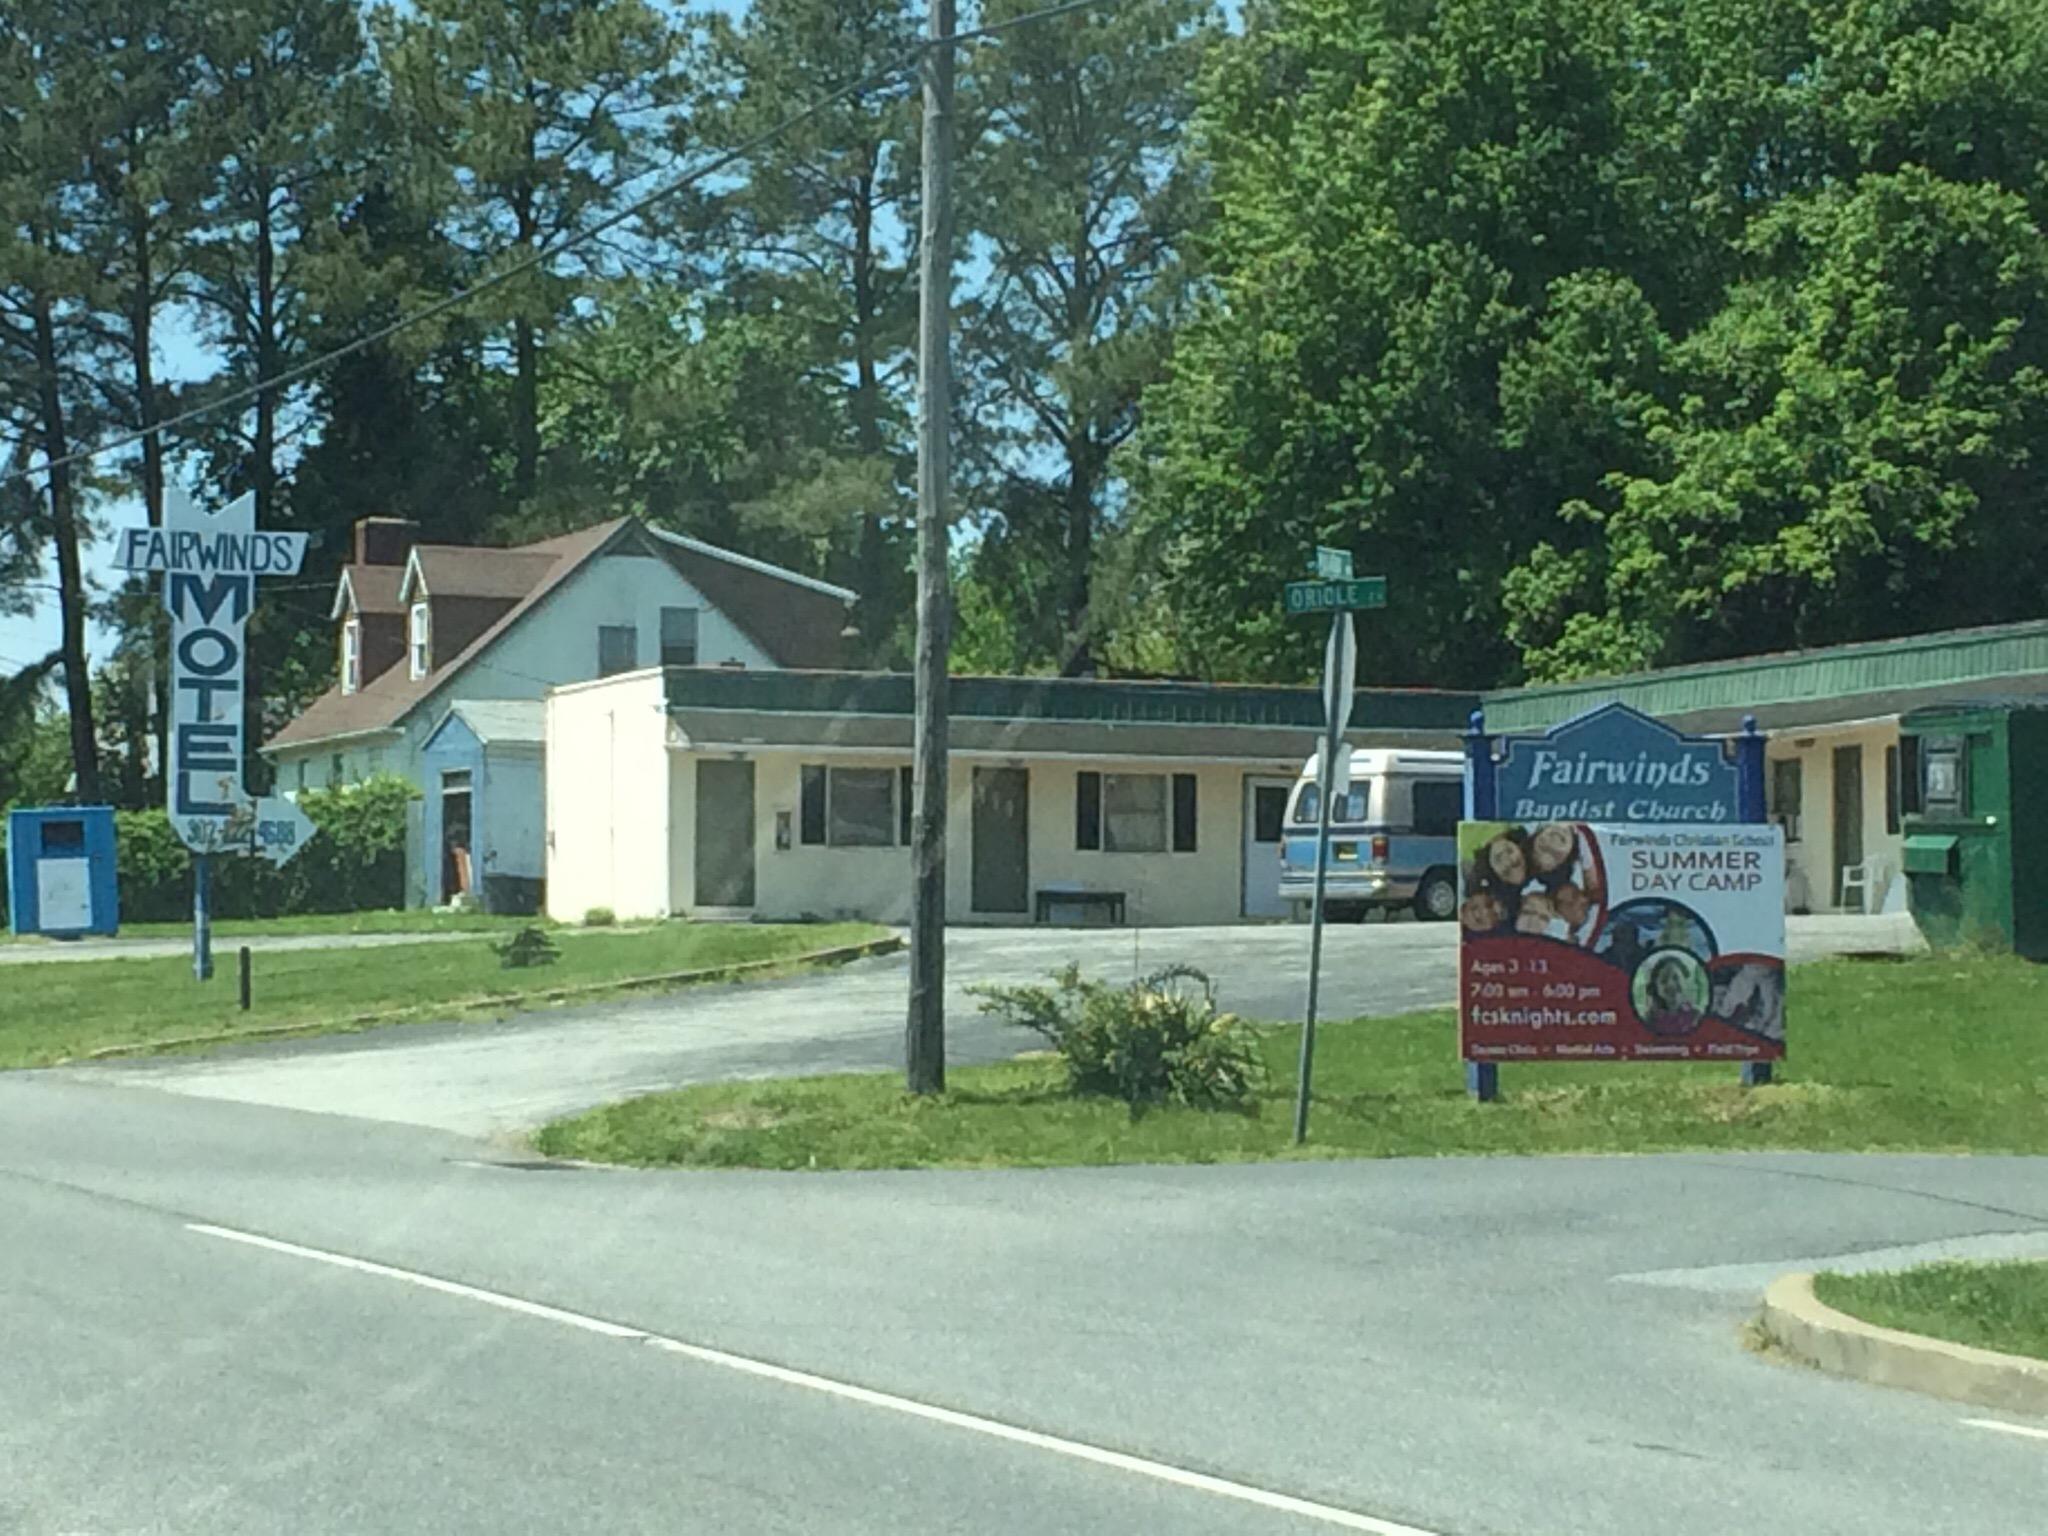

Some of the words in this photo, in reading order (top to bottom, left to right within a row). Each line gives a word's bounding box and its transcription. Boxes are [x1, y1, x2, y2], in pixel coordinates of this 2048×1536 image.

[126, 528, 293, 572] FAIRWINDS
[1291, 584, 1358, 608] ORIOLE
[169, 572, 249, 816] MOTEL
[1527, 750, 1711, 790] Fairwinds
[1515, 799, 1615, 821] Baptist
[1627, 799, 1727, 821] Church
[1631, 850, 1762, 870] SUMMER
[1631, 872, 1683, 892] DAY
[1688, 872, 1763, 892] CAMP
[1470, 1004, 1618, 1030] fcsknights.com
